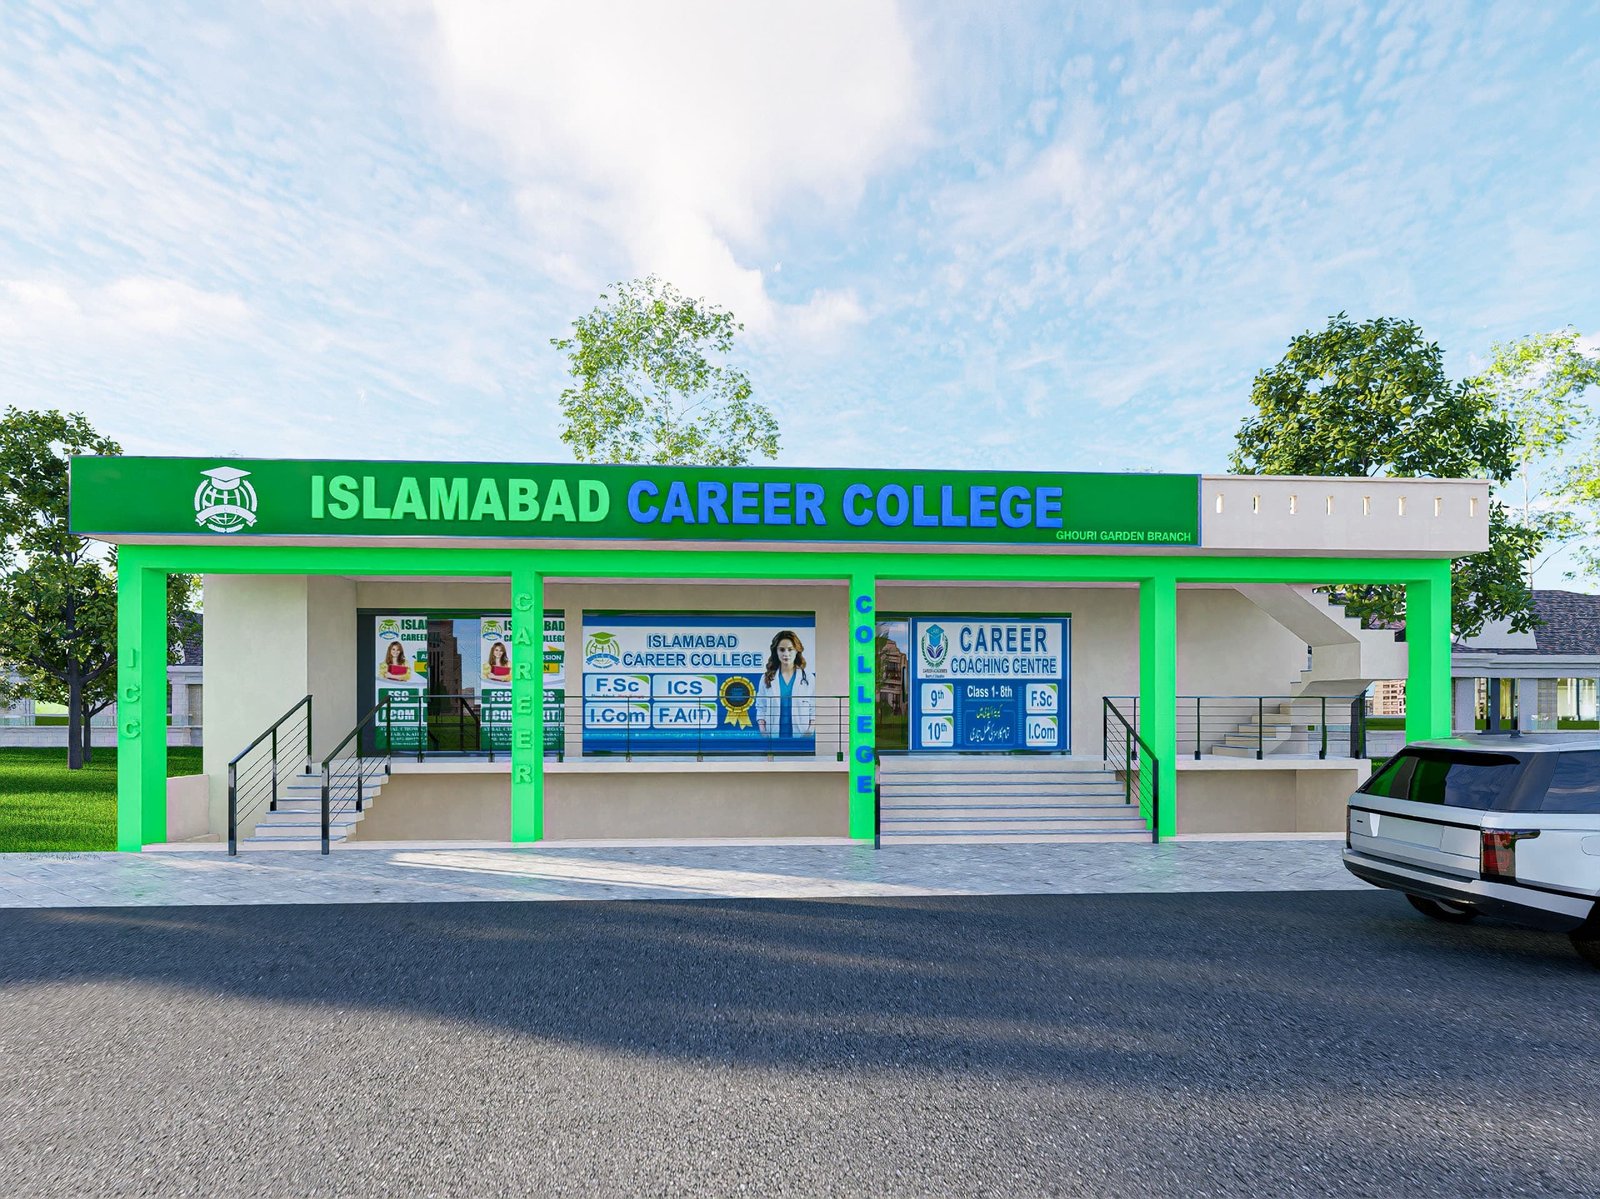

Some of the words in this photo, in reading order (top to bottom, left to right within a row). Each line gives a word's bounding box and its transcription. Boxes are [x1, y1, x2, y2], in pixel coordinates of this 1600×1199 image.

[310, 475, 610, 522] ISLAMABAD
[627, 480, 826, 526] CAREER
[842, 483, 1063, 529] COLLEGE
[1056, 531, 1097, 541] GHOURI
[1100, 531, 1144, 541] GARDEN
[1147, 532, 1191, 541] BRANCH
[401, 619, 428, 630] ISLA
[648, 635, 738, 648] ISLAMABAD
[960, 627, 1048, 652] CAREER
[623, 653, 686, 666] CAREER
[690, 653, 763, 667] COLLEGE
[951, 658, 1010, 674] COACHING
[1012, 658, 1057, 674] CENTRE
[514, 592, 533, 784] CAREER
[596, 678, 639, 692] F.Sc
[667, 680, 703, 695] ICS
[967, 685, 989, 698] Class
[856, 595, 874, 793] COLLEGE
[930, 689, 945, 708] 9th
[1031, 690, 1052, 707] F.Sc
[589, 708, 645, 722] I.Com
[659, 708, 711, 723] F.A(IT)
[927, 722, 948, 740] 10th
[1028, 723, 1056, 739] I.Com
